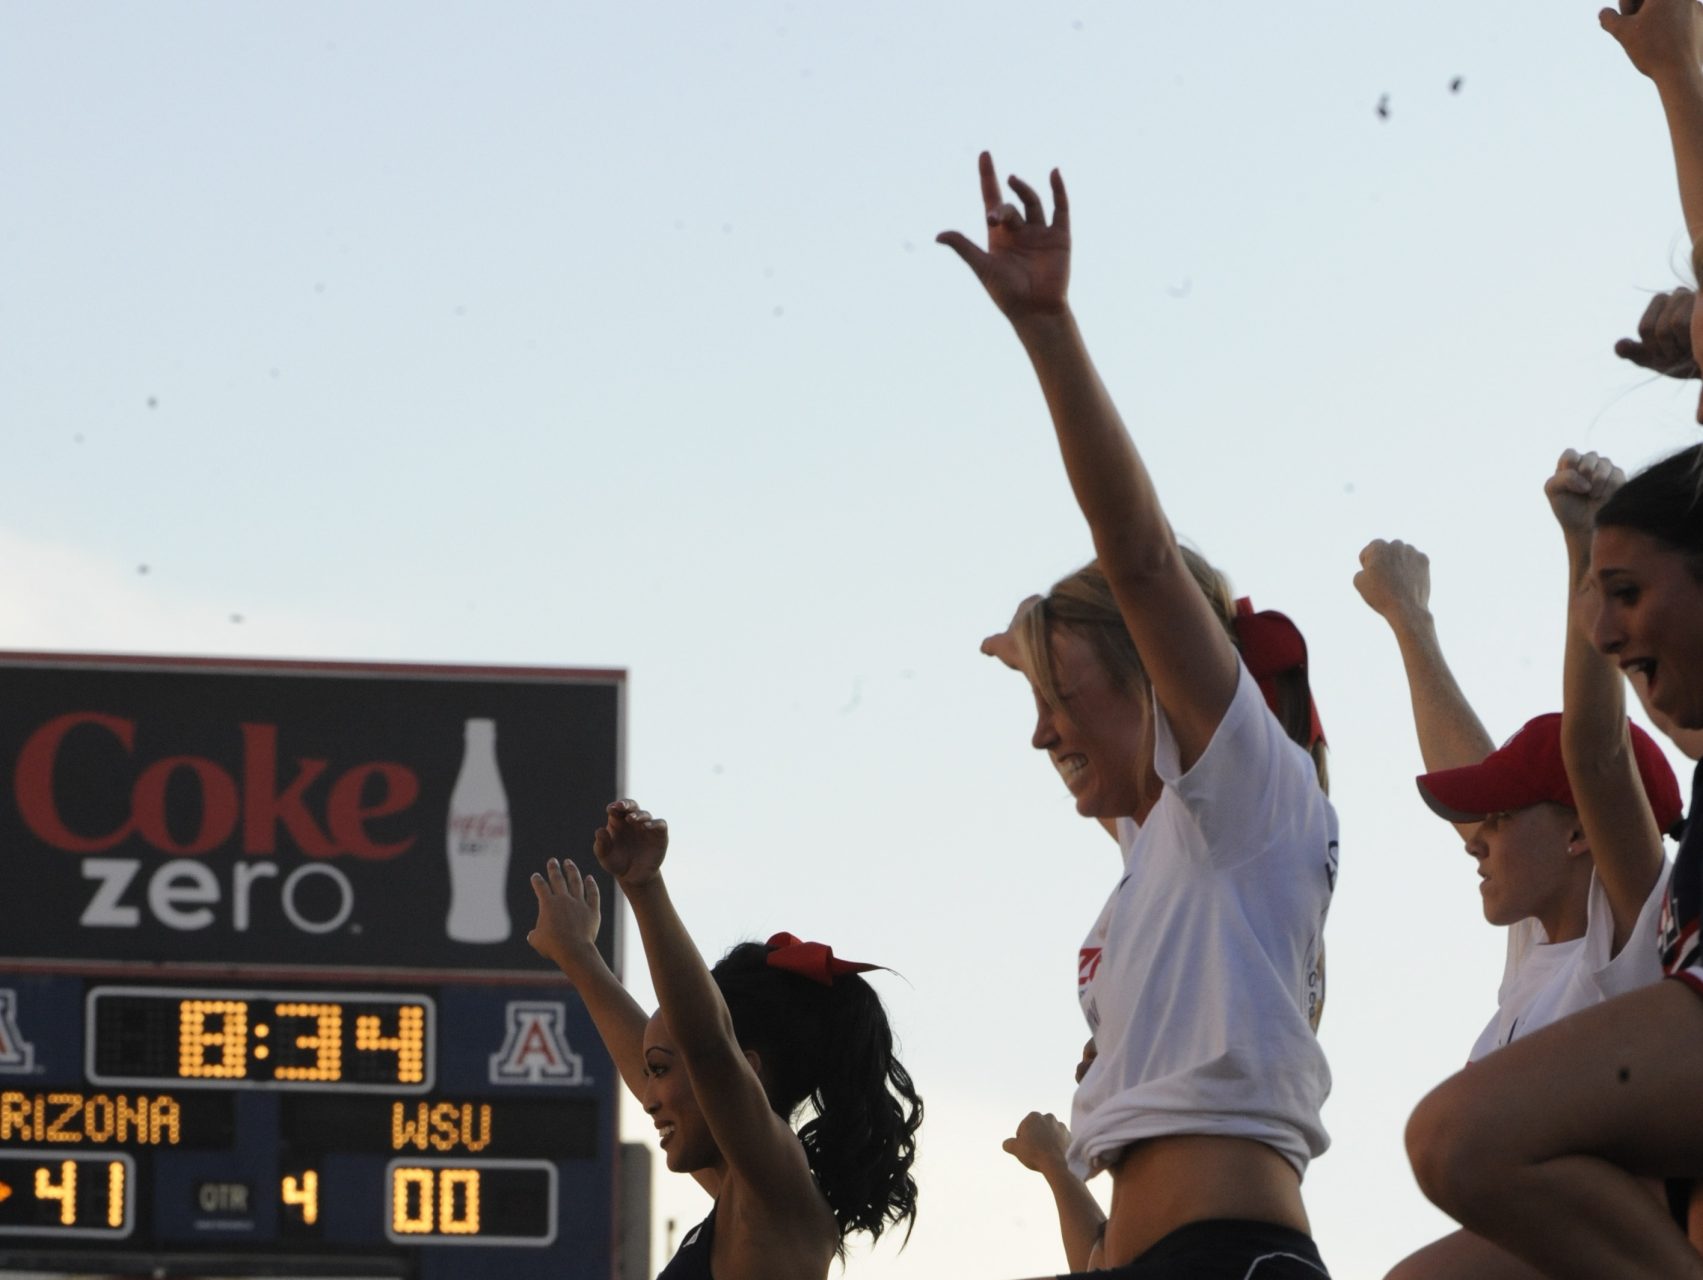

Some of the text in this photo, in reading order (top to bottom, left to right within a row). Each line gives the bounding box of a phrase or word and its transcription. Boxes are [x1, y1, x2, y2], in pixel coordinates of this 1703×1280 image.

[13, 711, 420, 860] Coke
[80, 857, 354, 934] zero
[179, 1000, 425, 1083] 8:34
[489, 1001, 583, 1085] A
[392, 1102, 491, 1150] WSU
[34, 1159, 125, 1227] 41
[282, 1169, 318, 1225] 4
[393, 1168, 480, 1233] 00
